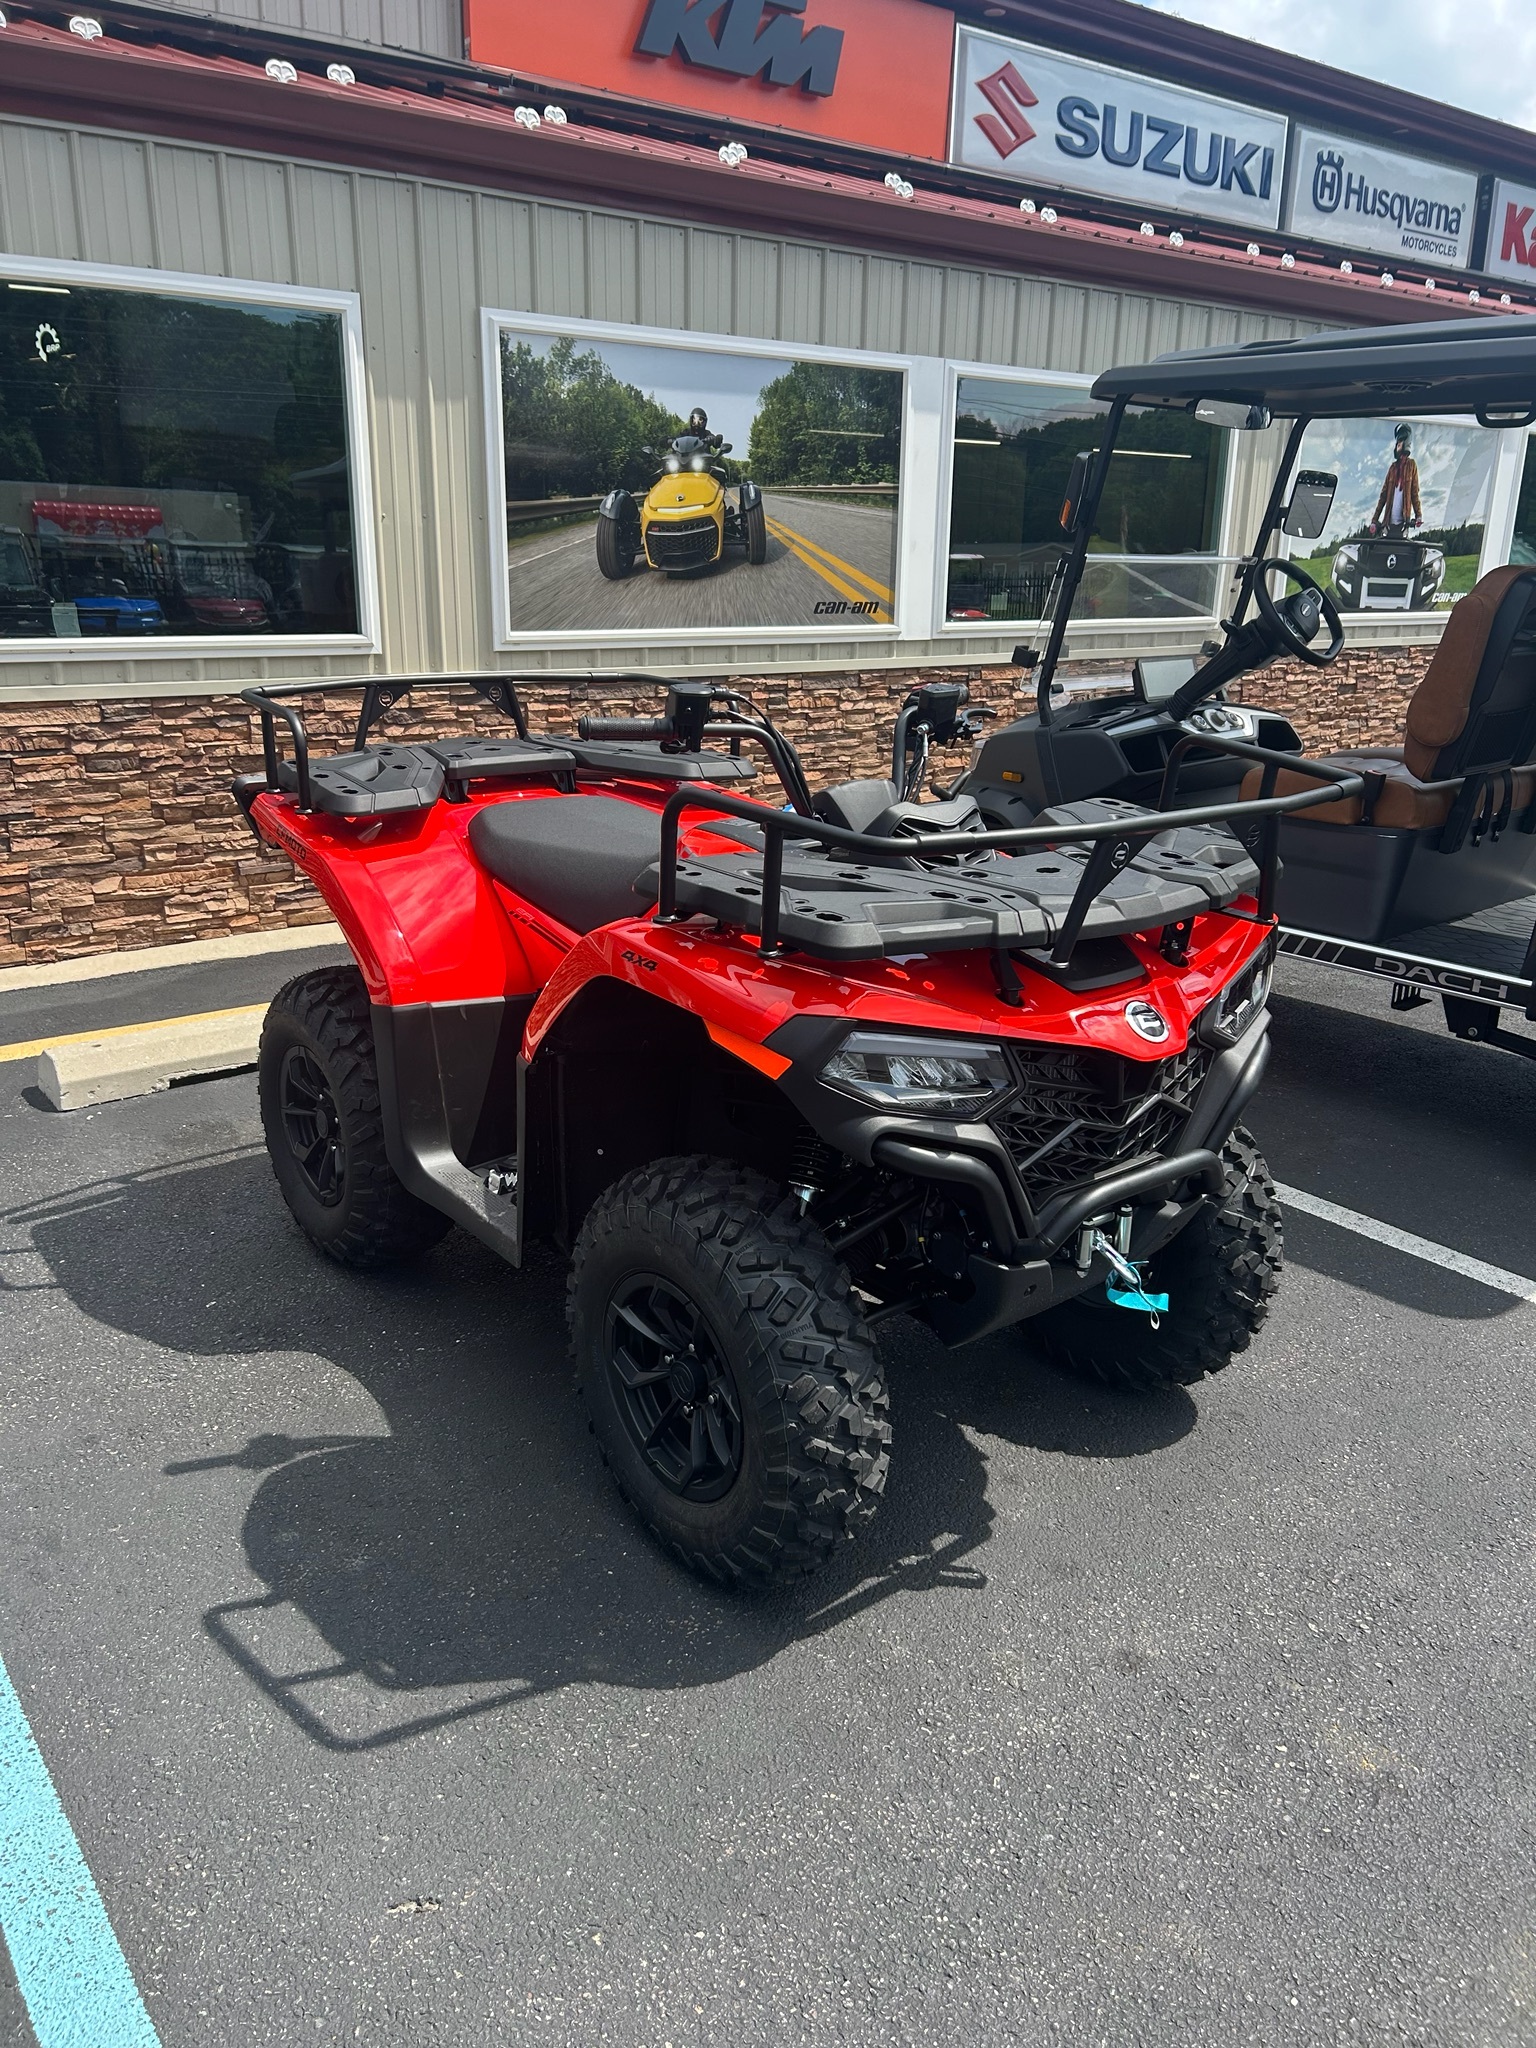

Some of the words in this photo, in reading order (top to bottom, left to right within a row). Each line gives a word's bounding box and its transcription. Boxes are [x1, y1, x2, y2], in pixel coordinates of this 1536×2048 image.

[633, 0, 845, 98] KTM
[1055, 95, 1275, 201] SUZUKI
[1344, 172, 1463, 235] Husqvarna
[1401, 235, 1458, 258] MOTORCYCLES
[813, 601, 880, 615] can-am
[1374, 957, 1508, 999] DACH
